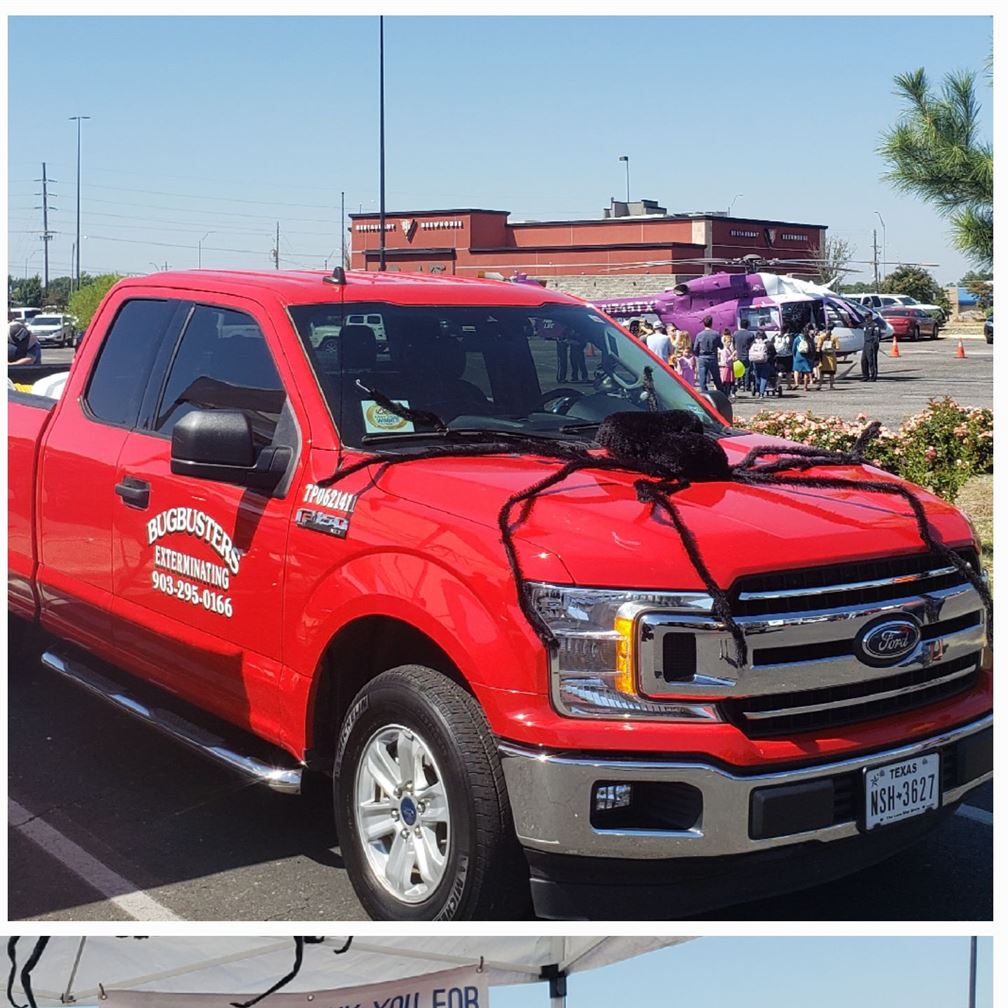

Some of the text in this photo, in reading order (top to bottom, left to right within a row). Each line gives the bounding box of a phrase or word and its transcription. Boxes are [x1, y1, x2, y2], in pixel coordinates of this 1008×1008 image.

[356, 223, 395, 231] RESTAUANT
[146, 507, 241, 575] BUGBUSTERS
[155, 545, 230, 590] EXTERMINATING
[152, 570, 233, 618] 903-295-0166
[878, 630, 909, 651] Ford
[889, 762, 918, 780] TEXAS
